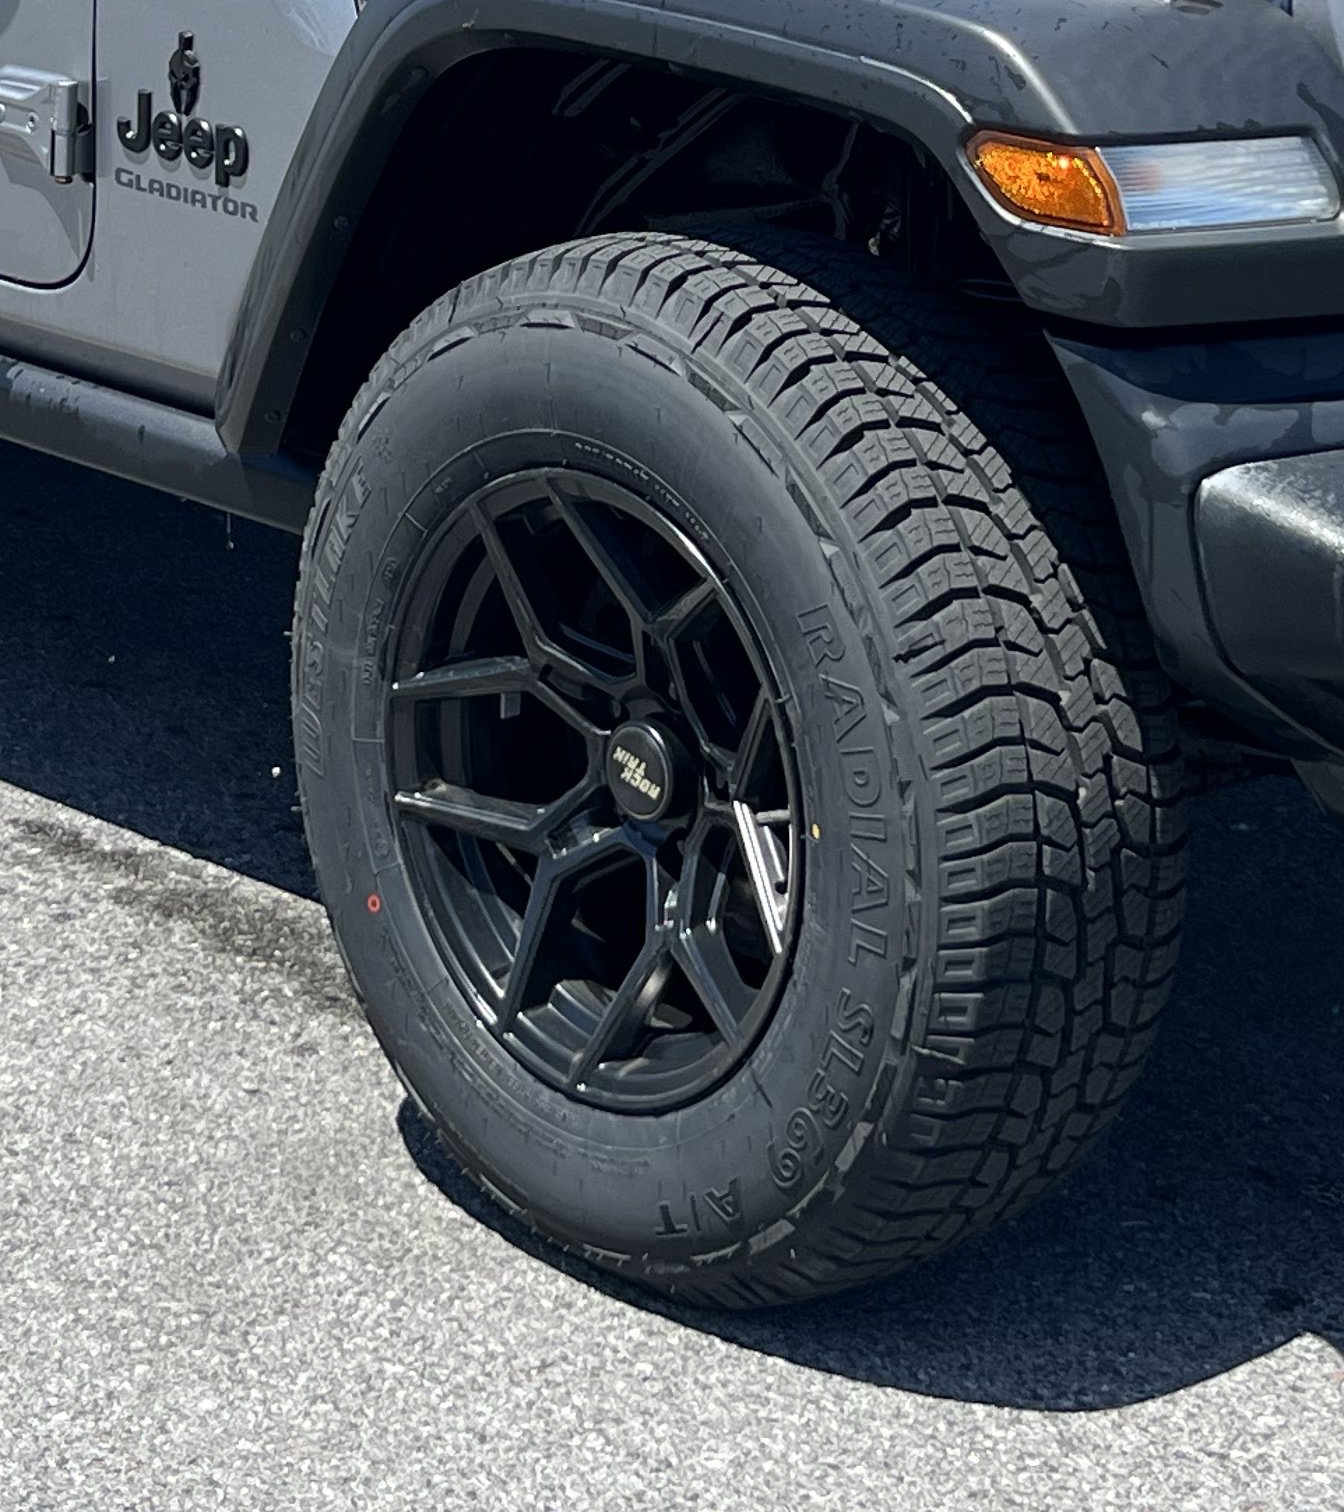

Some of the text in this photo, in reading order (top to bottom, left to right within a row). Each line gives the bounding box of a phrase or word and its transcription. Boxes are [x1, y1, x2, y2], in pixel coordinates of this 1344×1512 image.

[117, 89, 249, 187] Jeep
[114, 167, 259, 223] GLADIATOR
[654, 601, 891, 1238] RADIAL SL369 A/T
